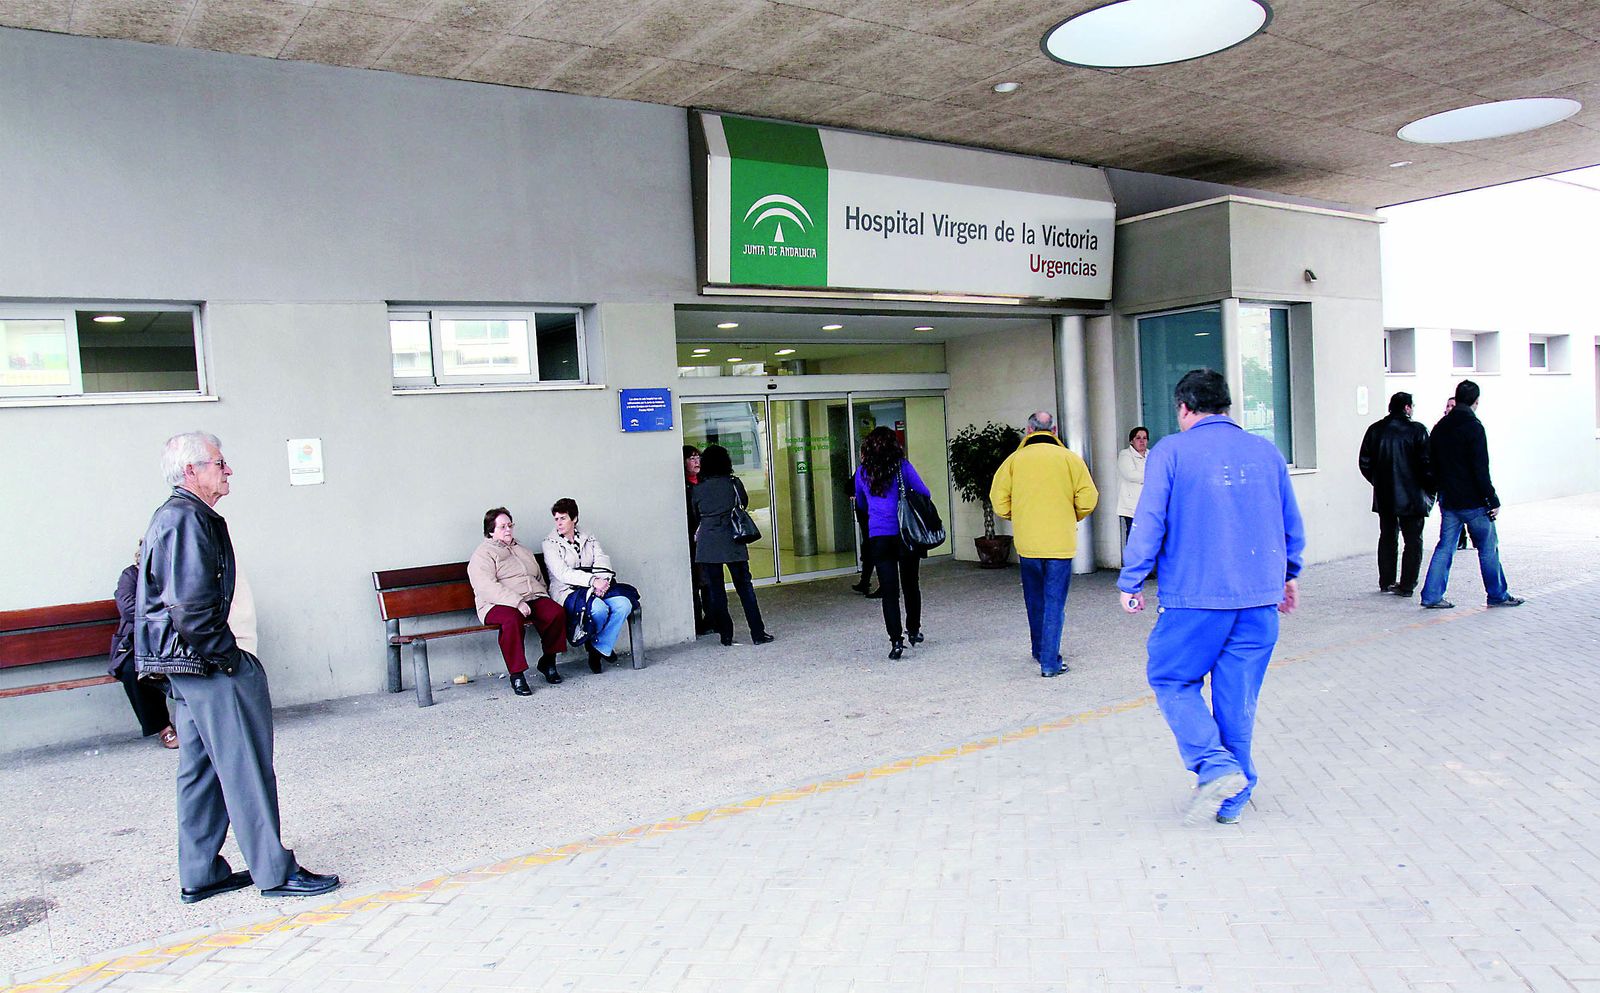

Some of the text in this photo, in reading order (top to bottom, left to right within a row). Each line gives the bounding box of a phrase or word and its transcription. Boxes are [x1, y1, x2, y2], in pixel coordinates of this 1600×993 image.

[845, 205, 1098, 250] Hospital Virgen de la Victoria
[743, 244, 766, 256] JUNTA
[768, 245, 778, 256] DE
[1030, 253, 1097, 278] Urgencias
